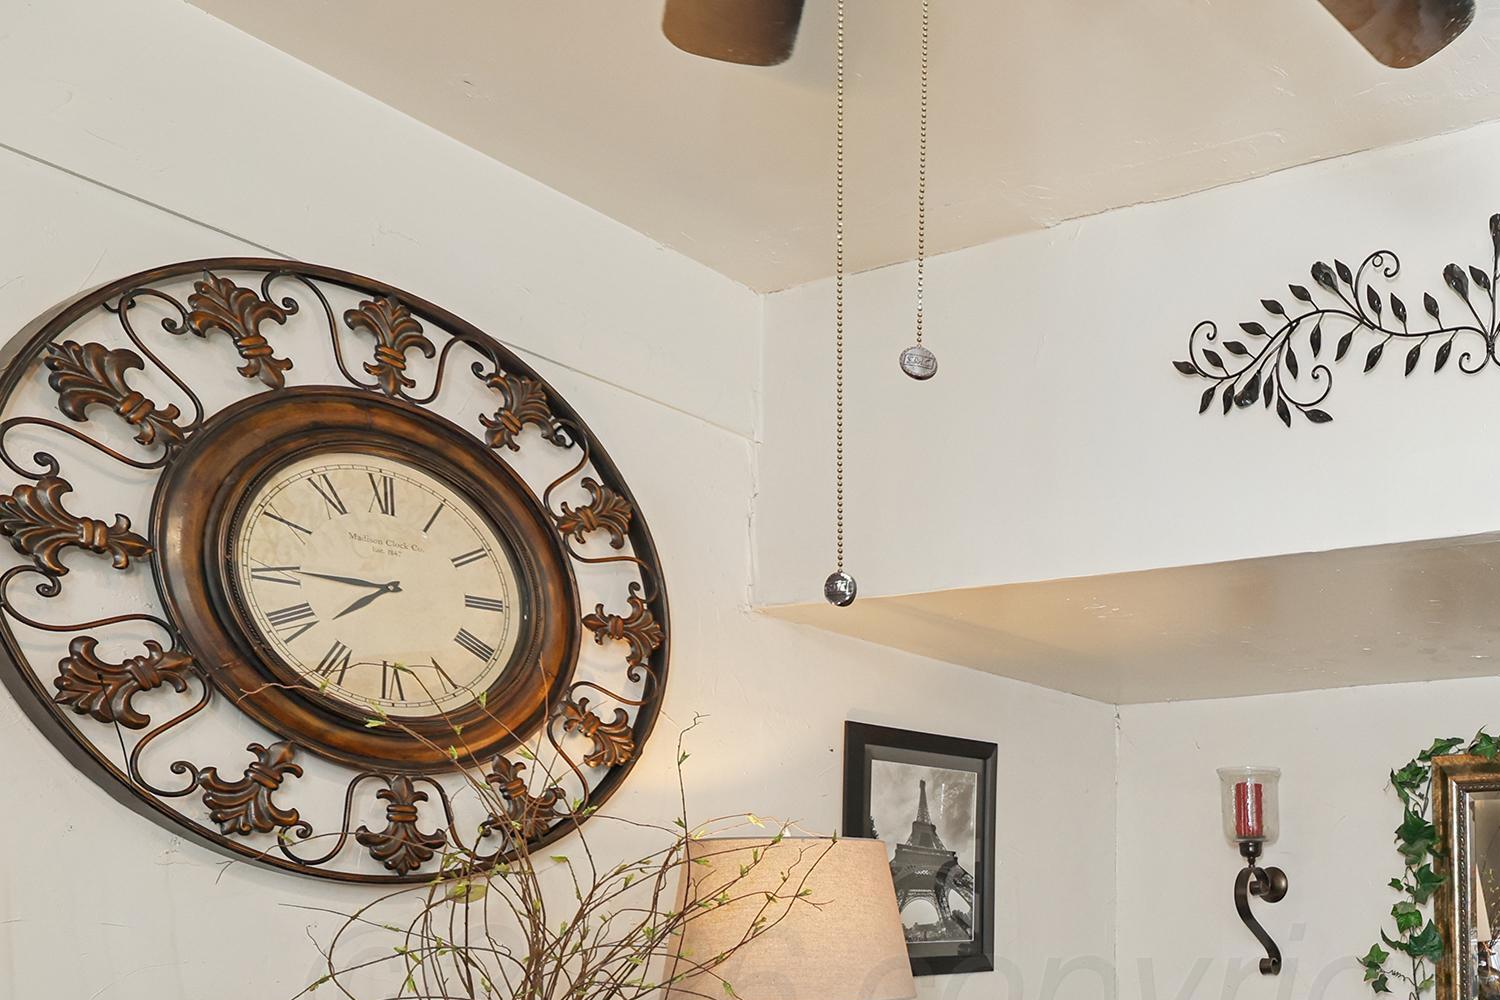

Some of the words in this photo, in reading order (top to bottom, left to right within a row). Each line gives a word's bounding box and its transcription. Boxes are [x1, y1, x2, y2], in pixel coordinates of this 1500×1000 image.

[368, 473, 395, 516] XII
[348, 531, 383, 545] Madison
[385, 539, 408, 550] Clock
[410, 544, 425, 553] Co.
